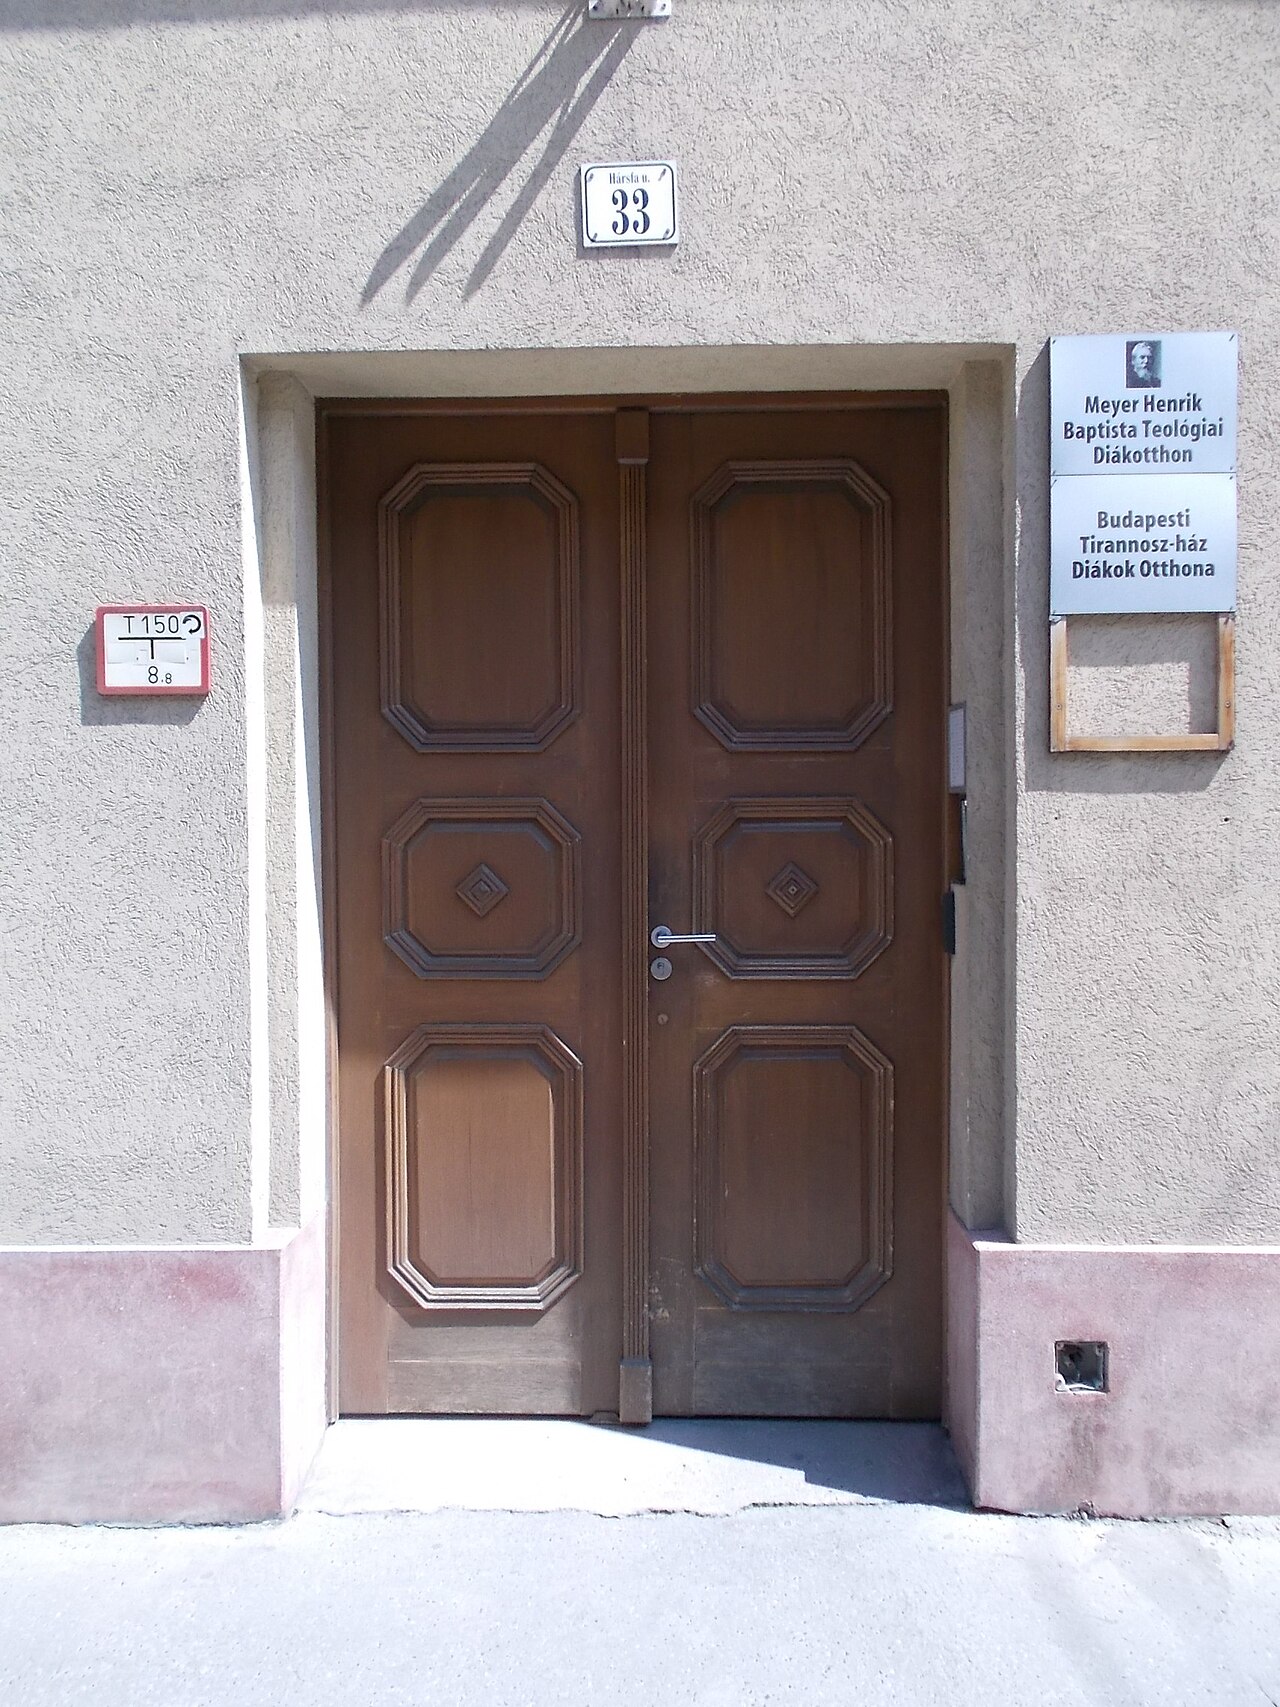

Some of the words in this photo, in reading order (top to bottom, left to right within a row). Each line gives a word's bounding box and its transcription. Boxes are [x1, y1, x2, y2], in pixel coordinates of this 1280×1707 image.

[642, 174, 650, 183] u.
[612, 188, 650, 235] 33
[1085, 395, 1139, 418] Meyer
[1143, 393, 1202, 413] Henrik
[1063, 420, 1137, 443] Baptista
[1142, 417, 1223, 442] Teológiai
[1094, 444, 1192, 464] Diákotthon
[1097, 508, 1190, 532] Budapesti
[1080, 534, 1208, 554] Tirannosz-ház
[1072, 559, 1135, 579] Diákok
[1139, 558, 1215, 578] Otthona
